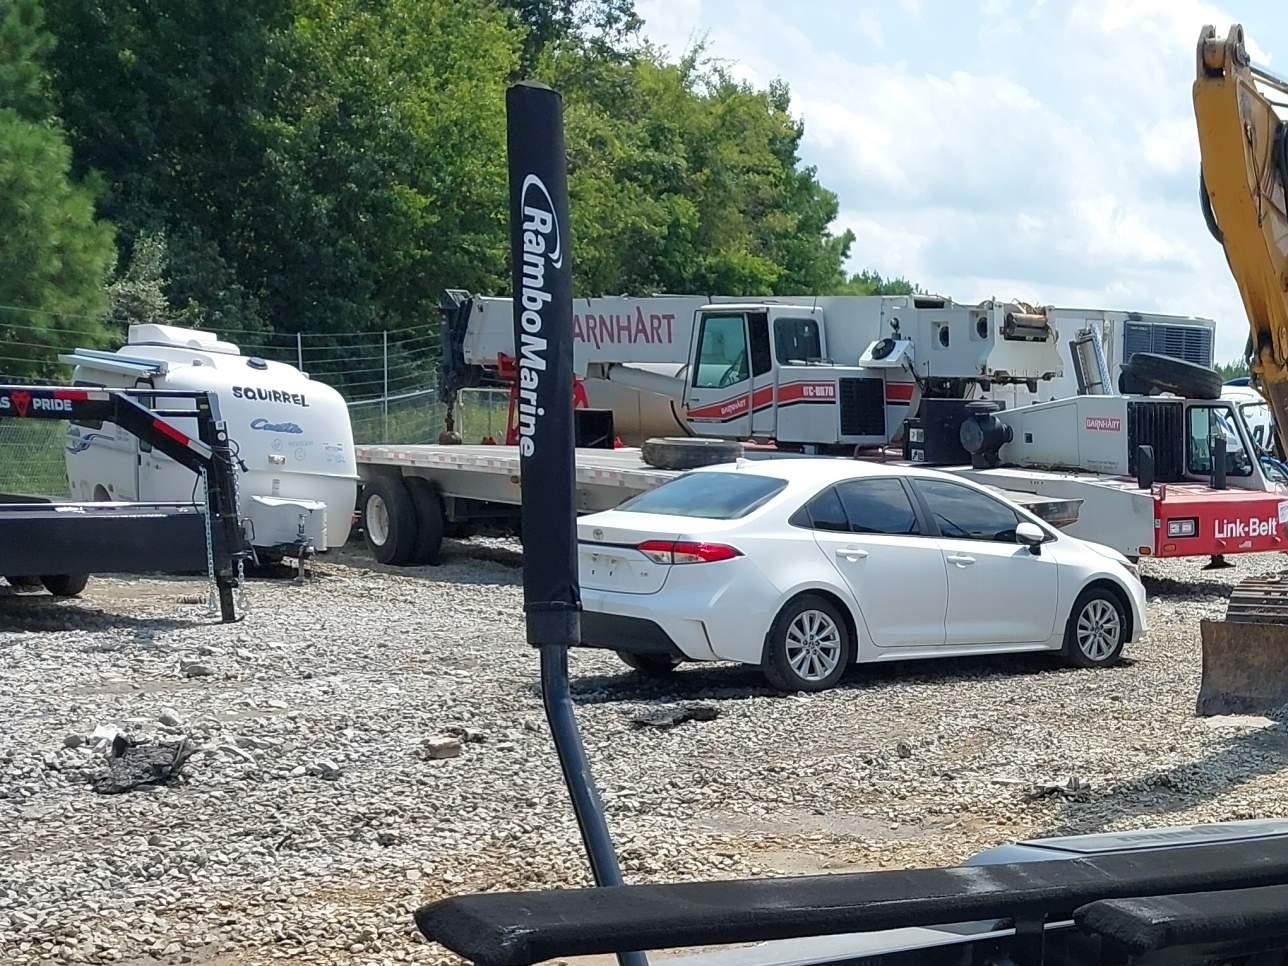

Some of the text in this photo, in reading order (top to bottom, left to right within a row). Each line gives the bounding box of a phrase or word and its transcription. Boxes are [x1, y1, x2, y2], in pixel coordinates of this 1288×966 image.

[572, 306, 676, 350] ARNHART
[33, 398, 73, 411] PRIDE
[232, 385, 310, 407] SQUIRREL
